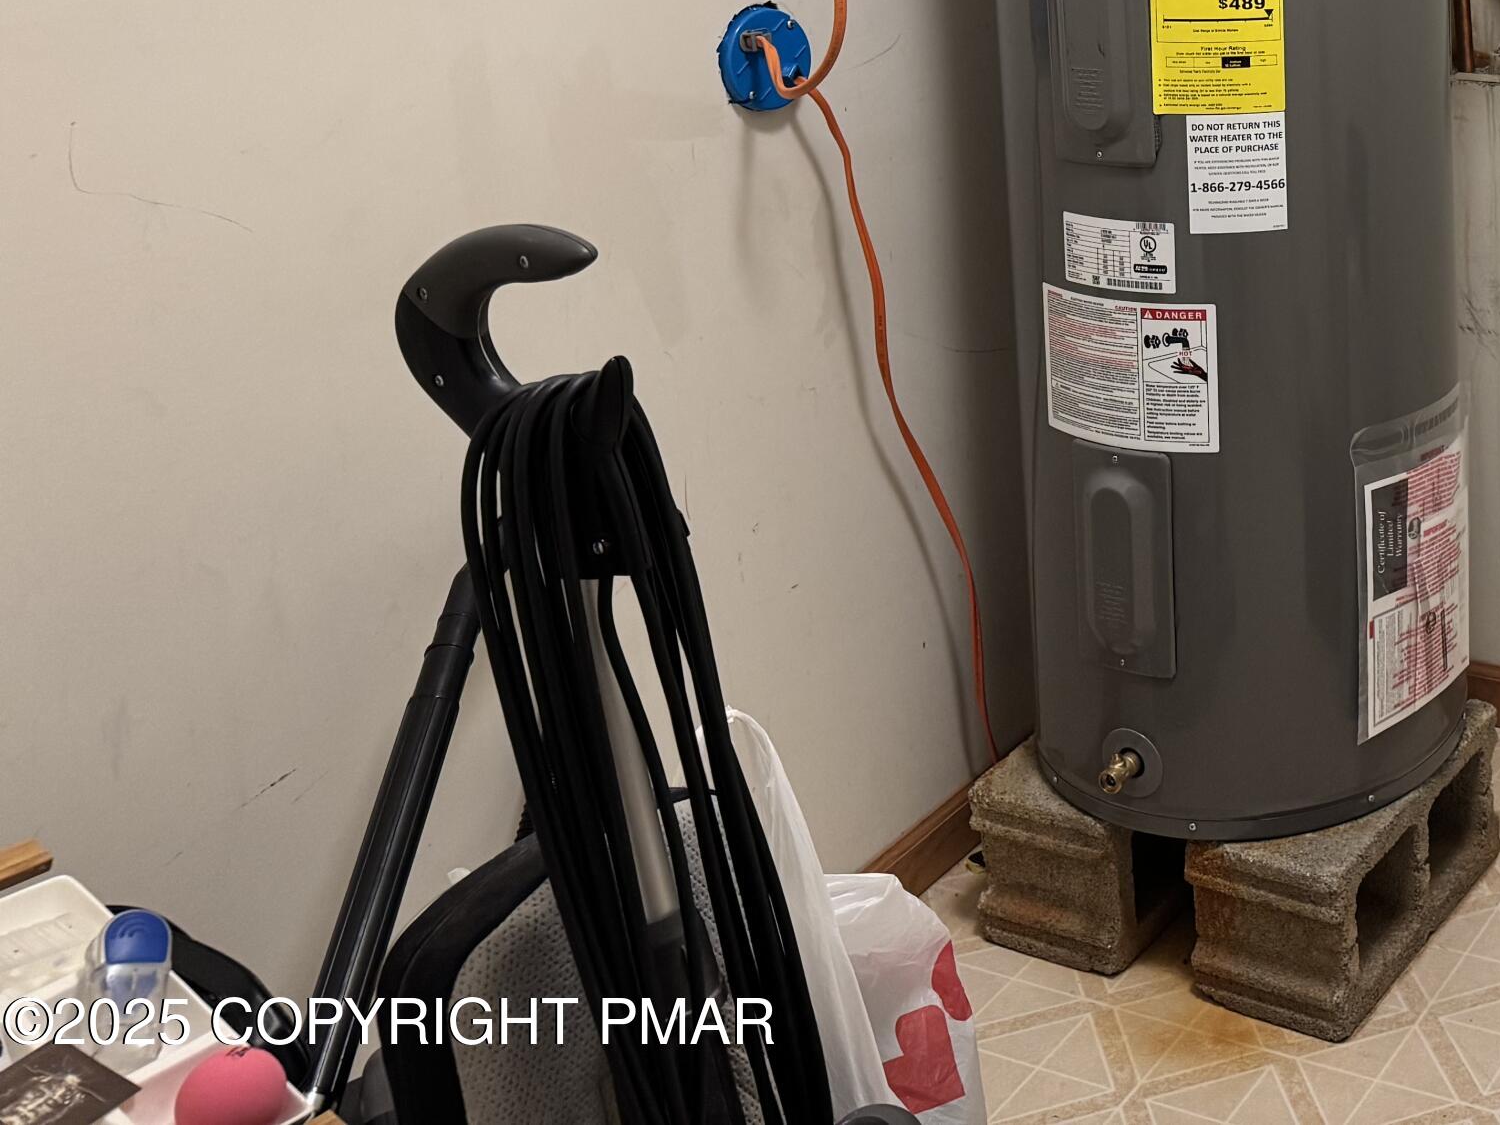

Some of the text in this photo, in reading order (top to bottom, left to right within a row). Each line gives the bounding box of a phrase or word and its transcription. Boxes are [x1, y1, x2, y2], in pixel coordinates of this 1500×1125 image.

[1191, 120, 1281, 132] DO NOT RETURN THIS
[1189, 131, 1283, 143] WATER HEATER TO THE
[1194, 143, 1279, 154] PLACE OF PURCHASE
[1190, 178, 1286, 193] 1-866-279-4566
[1155, 311, 1202, 320] DANGER
[1386, 520, 1394, 556] Limited
[1395, 514, 1403, 557] Warranty
[1377, 511, 1387, 574] Certificate of
